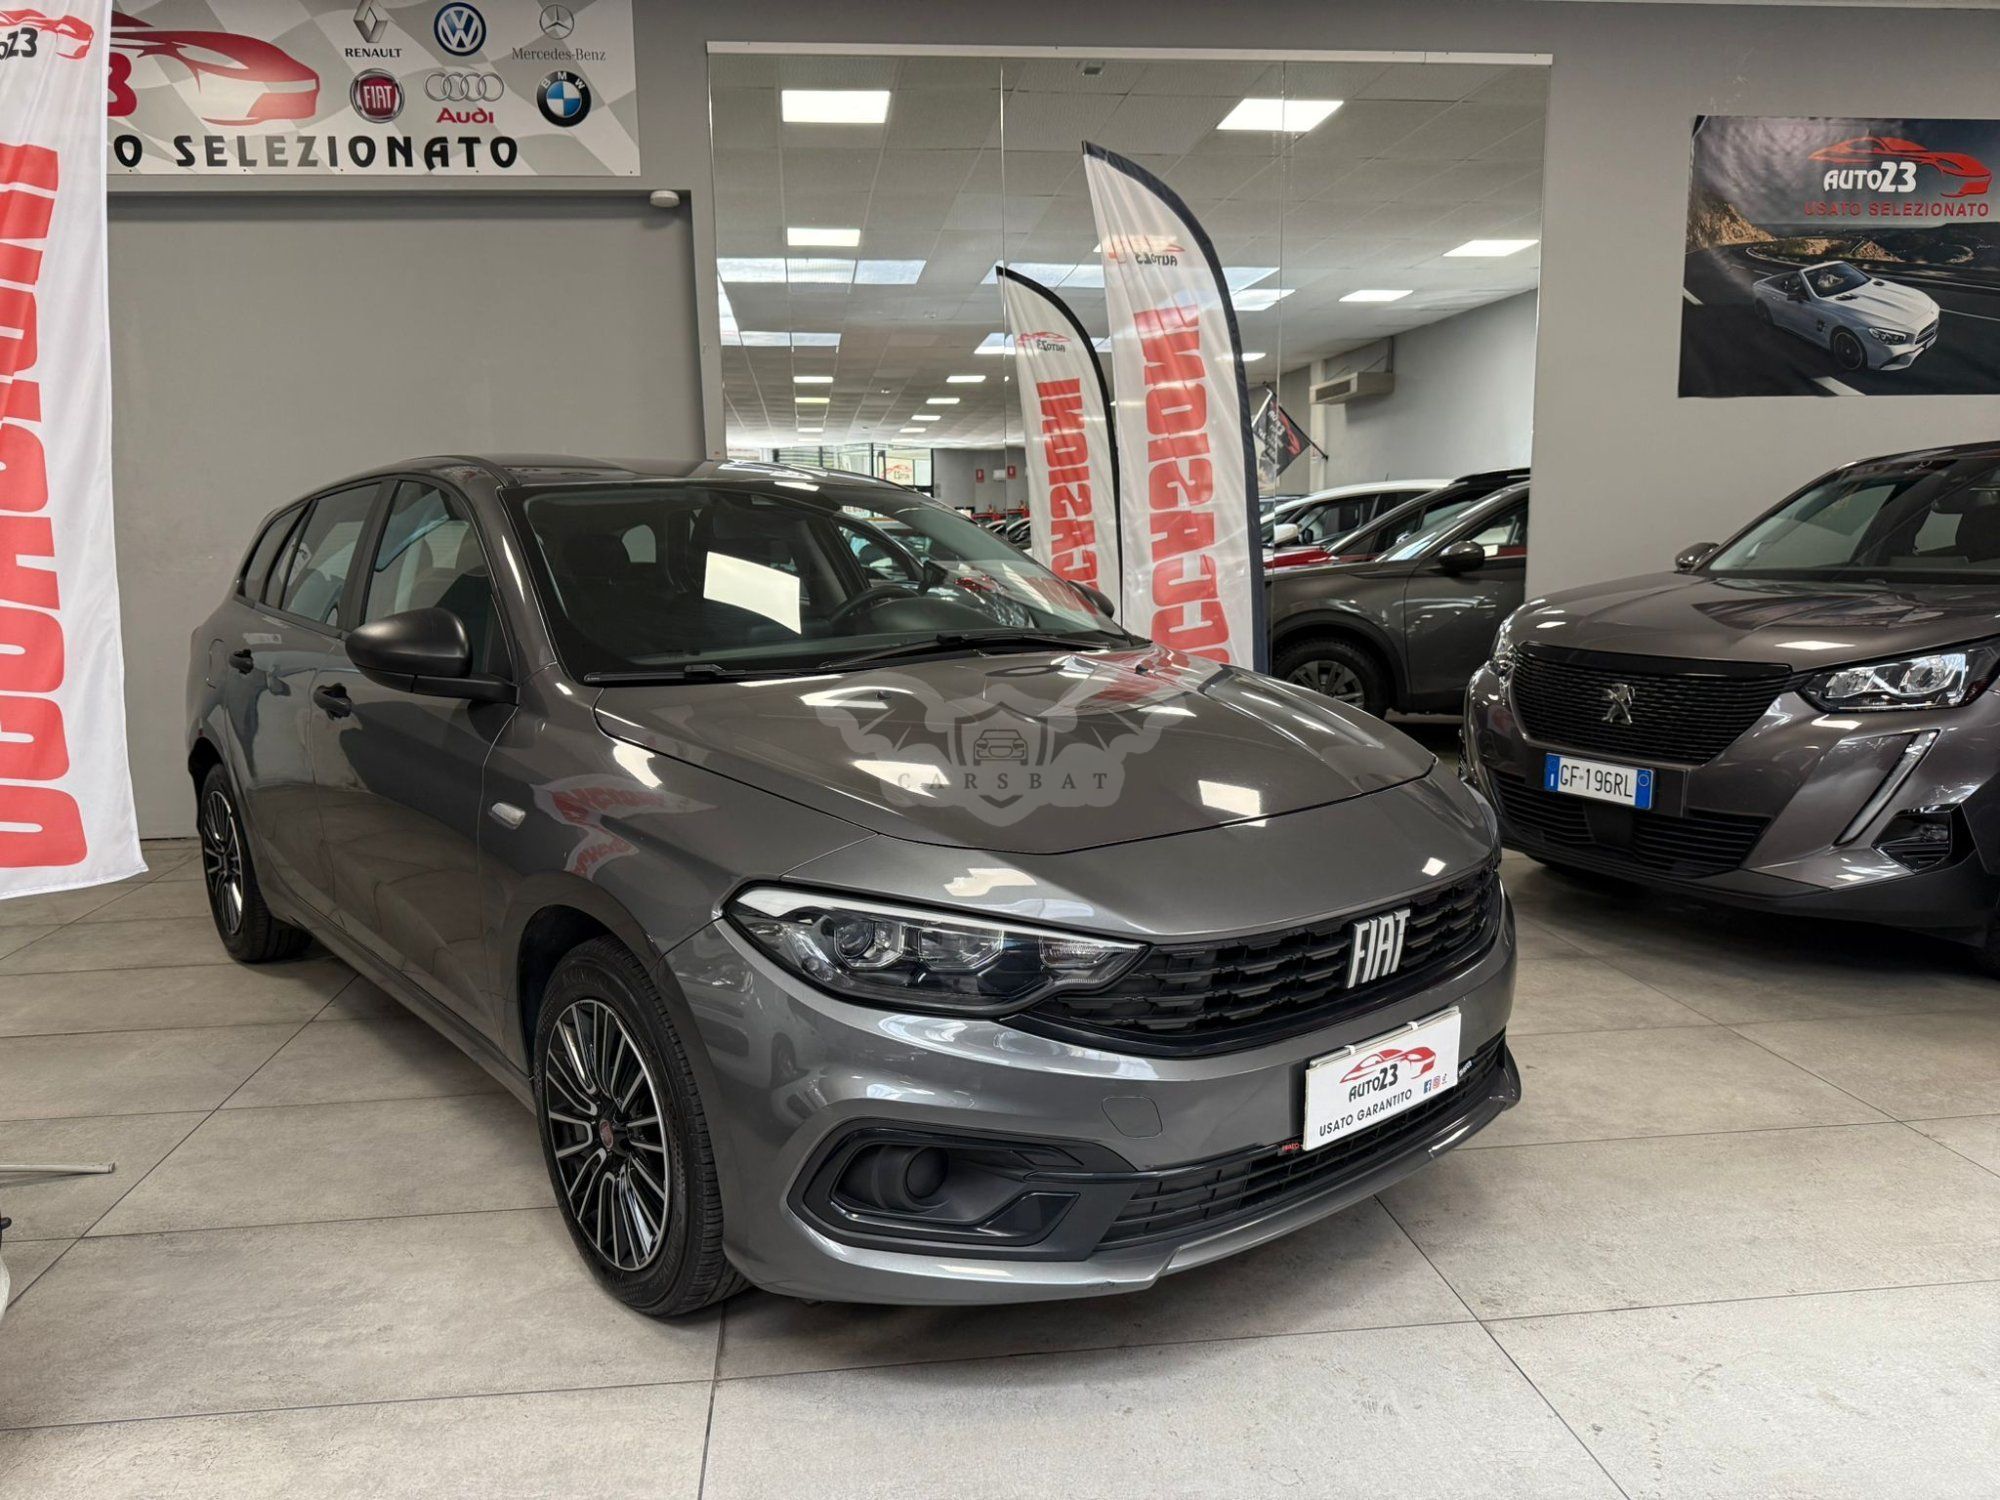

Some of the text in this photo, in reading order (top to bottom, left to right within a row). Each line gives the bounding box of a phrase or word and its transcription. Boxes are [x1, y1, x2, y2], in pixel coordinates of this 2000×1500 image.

[345, 47, 402, 58] RENAULT
[511, 47, 607, 61] Mercedes-Benz
[362, 84, 393, 110] FIAT
[436, 107, 494, 124] Audi
[173, 135, 518, 171] SELEZIONATO
[1823, 161, 1917, 193] AUTO23
[1804, 202, 1990, 218] USATO SELEZIONATO
[1347, 909, 1411, 989] FIAT
[1348, 1063, 1398, 1102] AUTO23
[1319, 1088, 1412, 1137] USATO GARANTITO
